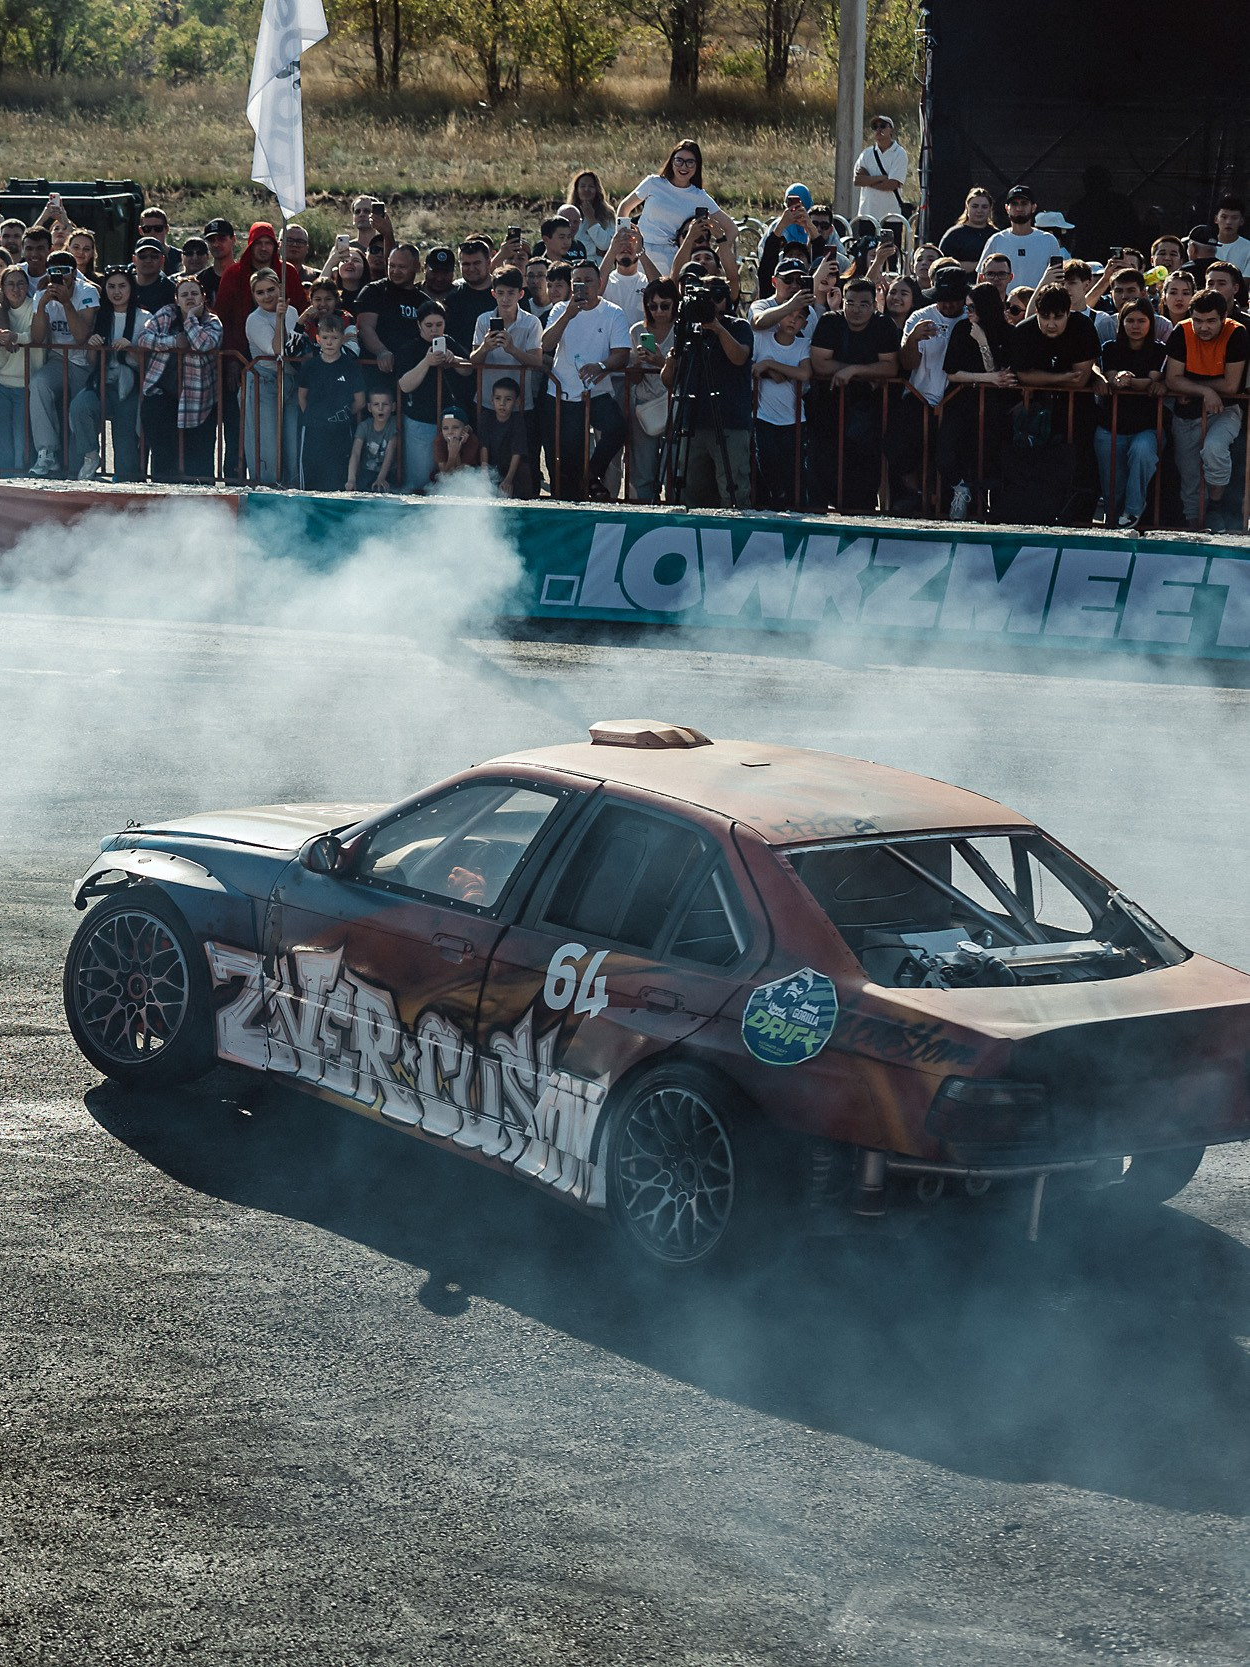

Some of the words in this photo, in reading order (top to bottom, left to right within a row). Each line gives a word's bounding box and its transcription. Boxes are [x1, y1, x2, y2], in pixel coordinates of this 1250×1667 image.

[543, 942, 610, 1019] 64
[745, 1008, 822, 1055] DRIFT
[791, 1008, 820, 1027] GORILLA
